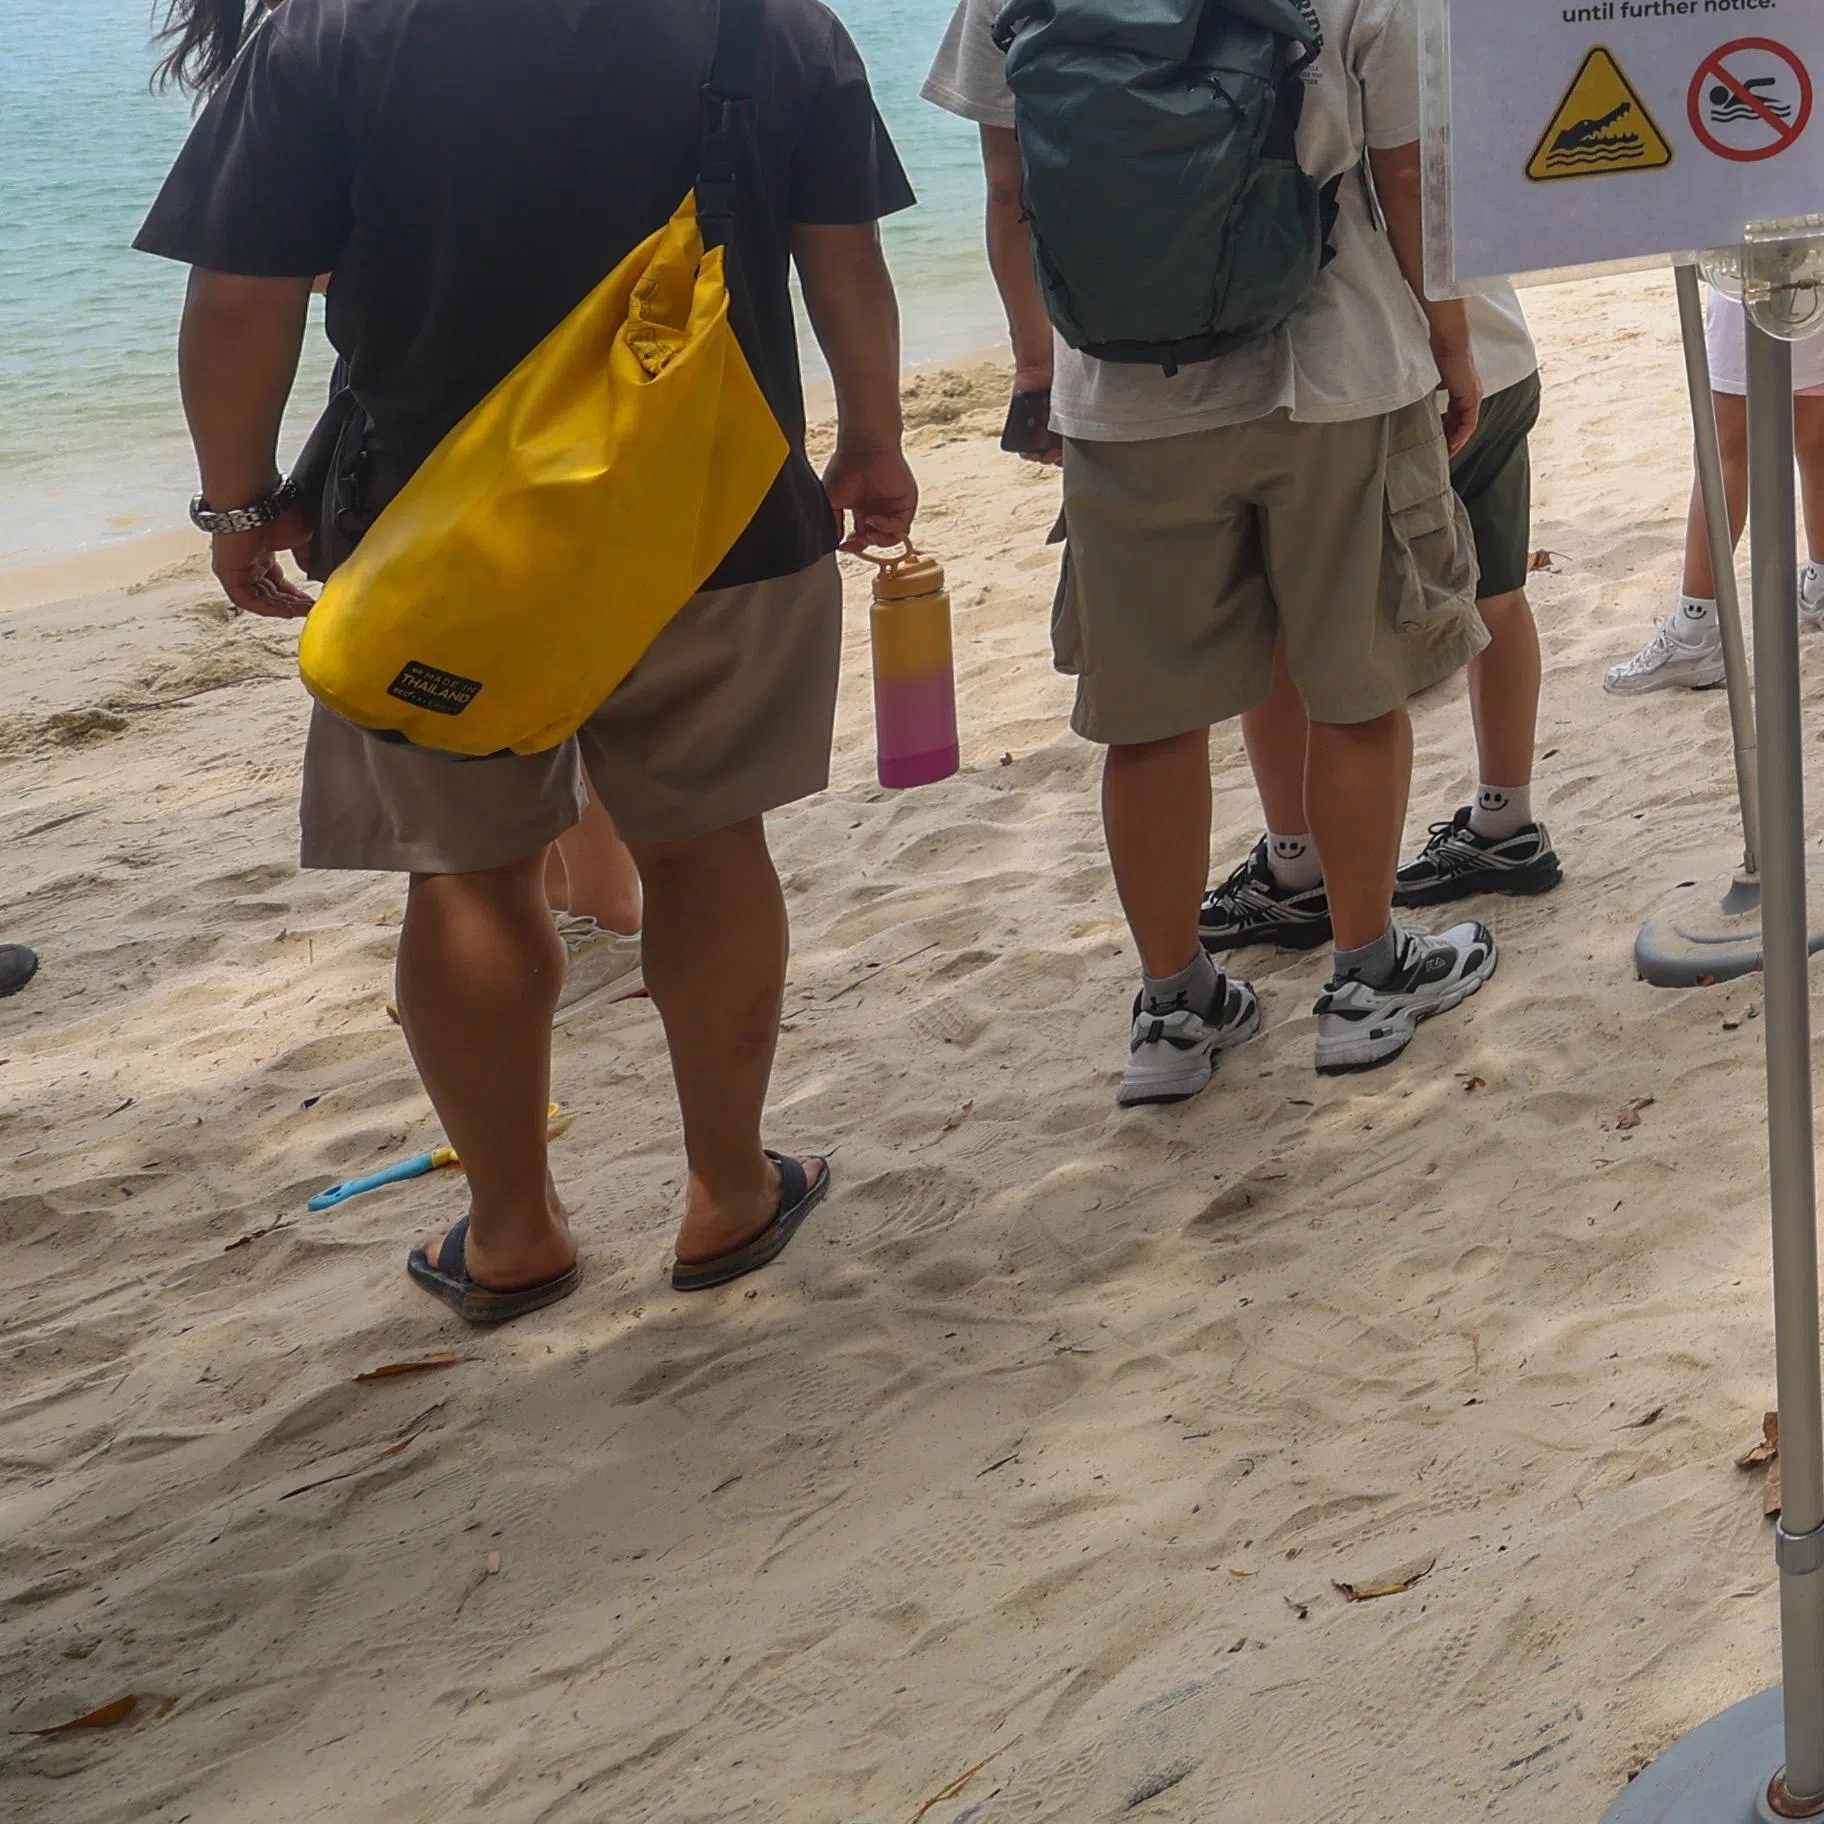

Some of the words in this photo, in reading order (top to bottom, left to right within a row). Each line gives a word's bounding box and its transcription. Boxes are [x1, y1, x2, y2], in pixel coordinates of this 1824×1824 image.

[1563, 2, 1614, 23] until
[1620, 0, 1698, 19] further
[400, 673, 470, 703] THAILAND
[423, 672, 459, 688] MADE
[463, 684, 477, 693] IN
